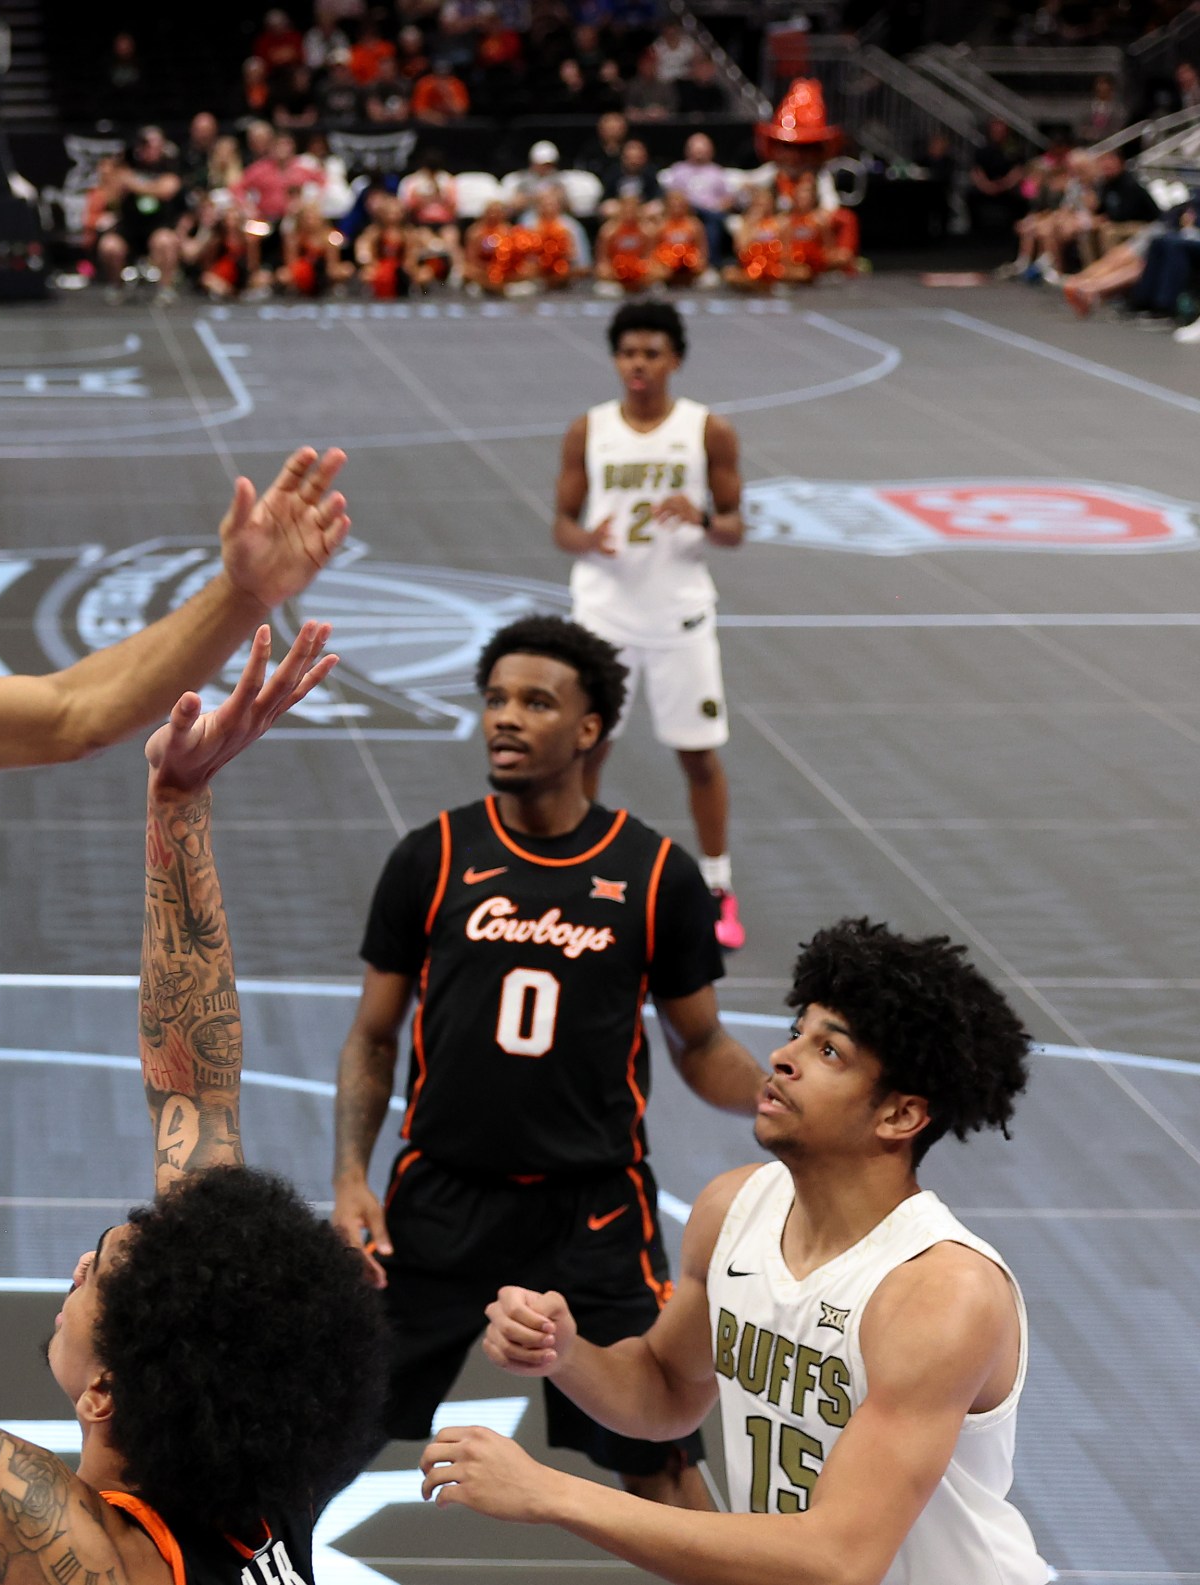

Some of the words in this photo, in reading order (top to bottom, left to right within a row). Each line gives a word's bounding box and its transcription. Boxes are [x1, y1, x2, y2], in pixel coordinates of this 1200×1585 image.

[604, 463, 686, 490] BUFFS
[629, 501, 652, 542] 2
[465, 896, 616, 959] Cowboys
[495, 966, 561, 1058] 0
[715, 1307, 851, 1428] BUFFS
[746, 1415, 824, 1514] 15
